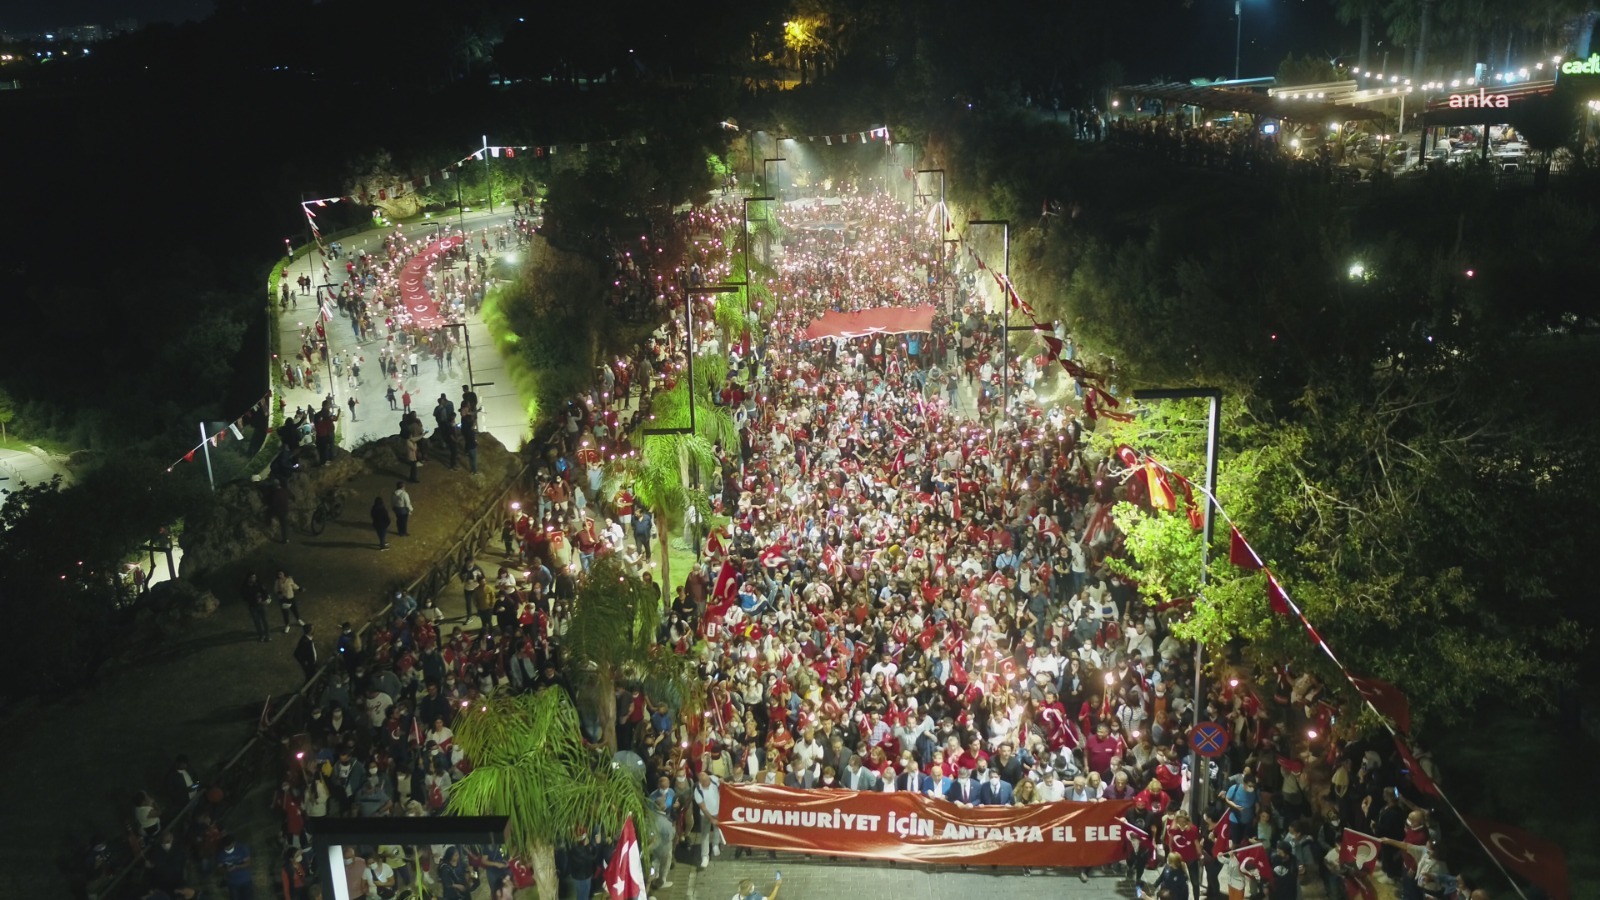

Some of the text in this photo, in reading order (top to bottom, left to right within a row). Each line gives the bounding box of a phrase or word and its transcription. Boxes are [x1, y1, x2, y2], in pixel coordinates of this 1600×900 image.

[731, 806, 1122, 842] CUMHURİYET İÇİN ANTALYA EL ELE
